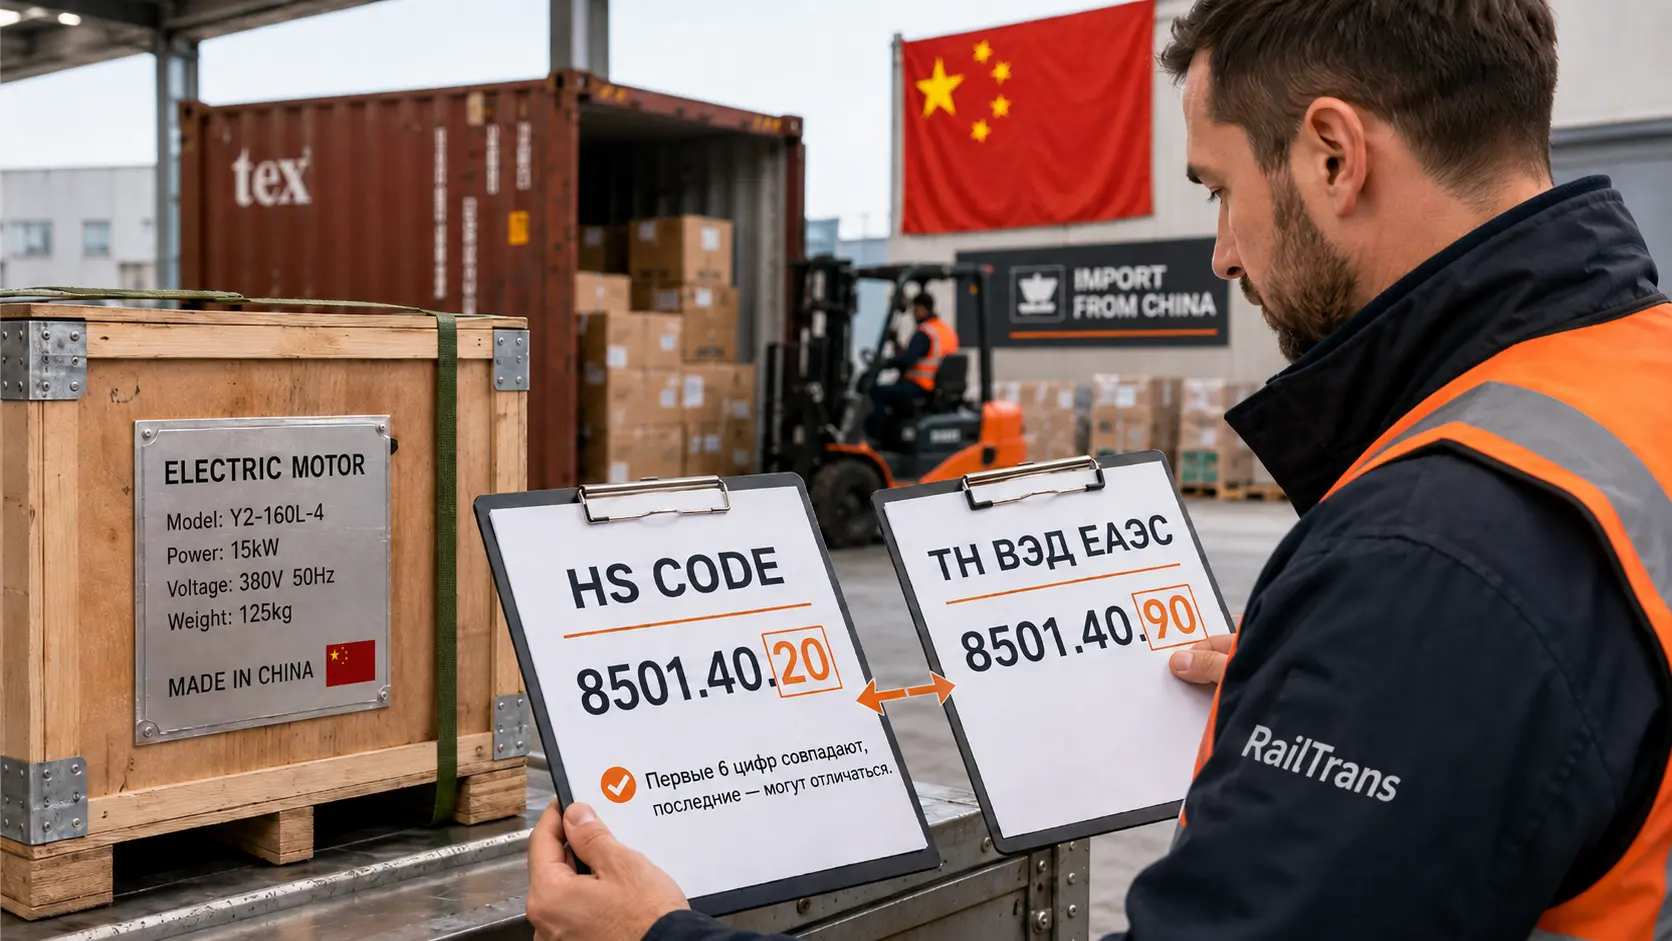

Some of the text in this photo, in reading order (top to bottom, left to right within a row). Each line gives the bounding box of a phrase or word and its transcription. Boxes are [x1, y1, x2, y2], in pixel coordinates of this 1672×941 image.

[1074, 264, 1167, 292] IMPORT
[1073, 291, 1217, 320] FROM CHINA
[164, 453, 365, 485] ELECTRIC MOTOR
[167, 503, 324, 531] Model: Y2-160L-4
[167, 538, 280, 565] Power: 15kW
[928, 514, 1174, 581] ТН ВЭД ЕАЭС
[167, 567, 336, 599] Voltage: 380V 50Hz
[566, 546, 785, 610] HS CODE
[168, 603, 293, 633] Weight: 125kg
[168, 660, 315, 698] MADE IN CHINA
[645, 739, 869, 791] Первые 6 цифр совпадают,
[1241, 724, 1401, 802] RailTrans
[652, 788, 742, 817] последние
[763, 779, 807, 800] могут
[810, 762, 894, 789] отличаться.
